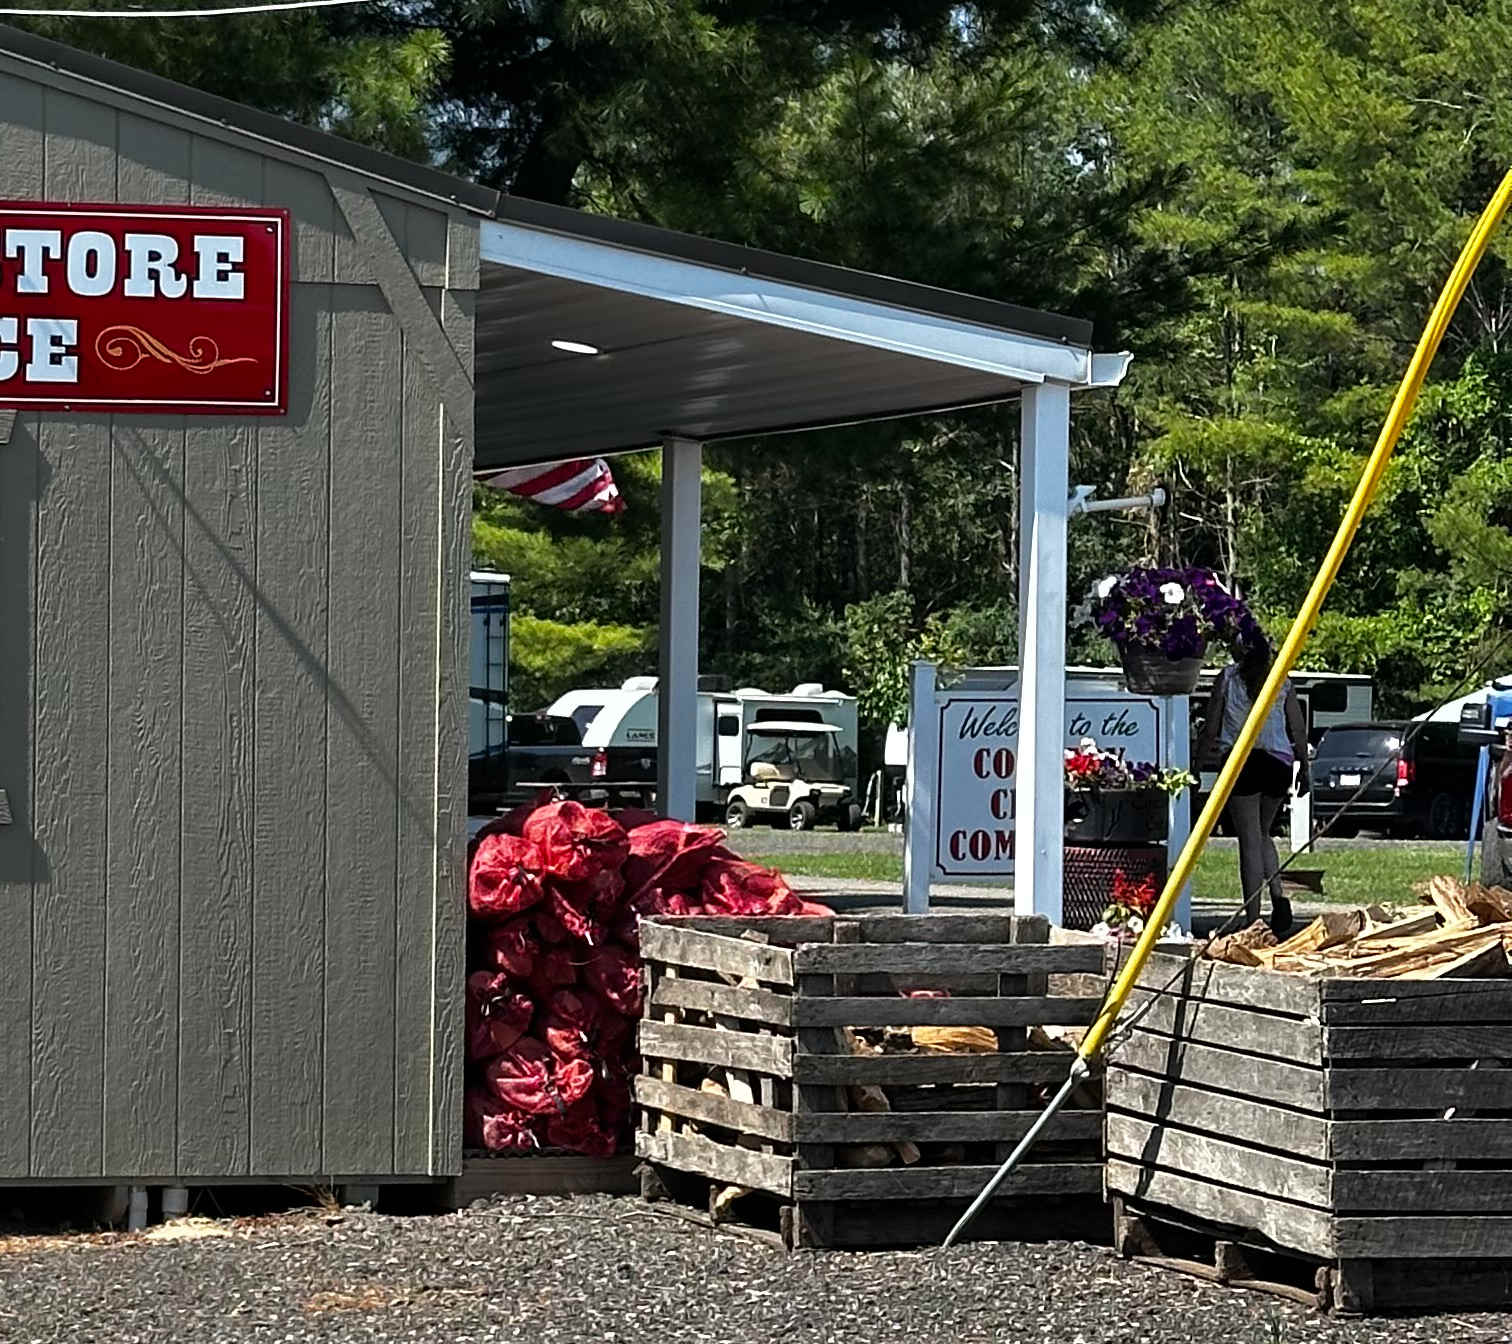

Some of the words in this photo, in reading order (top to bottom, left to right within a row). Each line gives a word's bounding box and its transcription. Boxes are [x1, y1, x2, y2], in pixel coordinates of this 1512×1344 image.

[958, 705, 1019, 739] Welc
[1068, 711, 1092, 737] to
[1100, 708, 1140, 737] the
